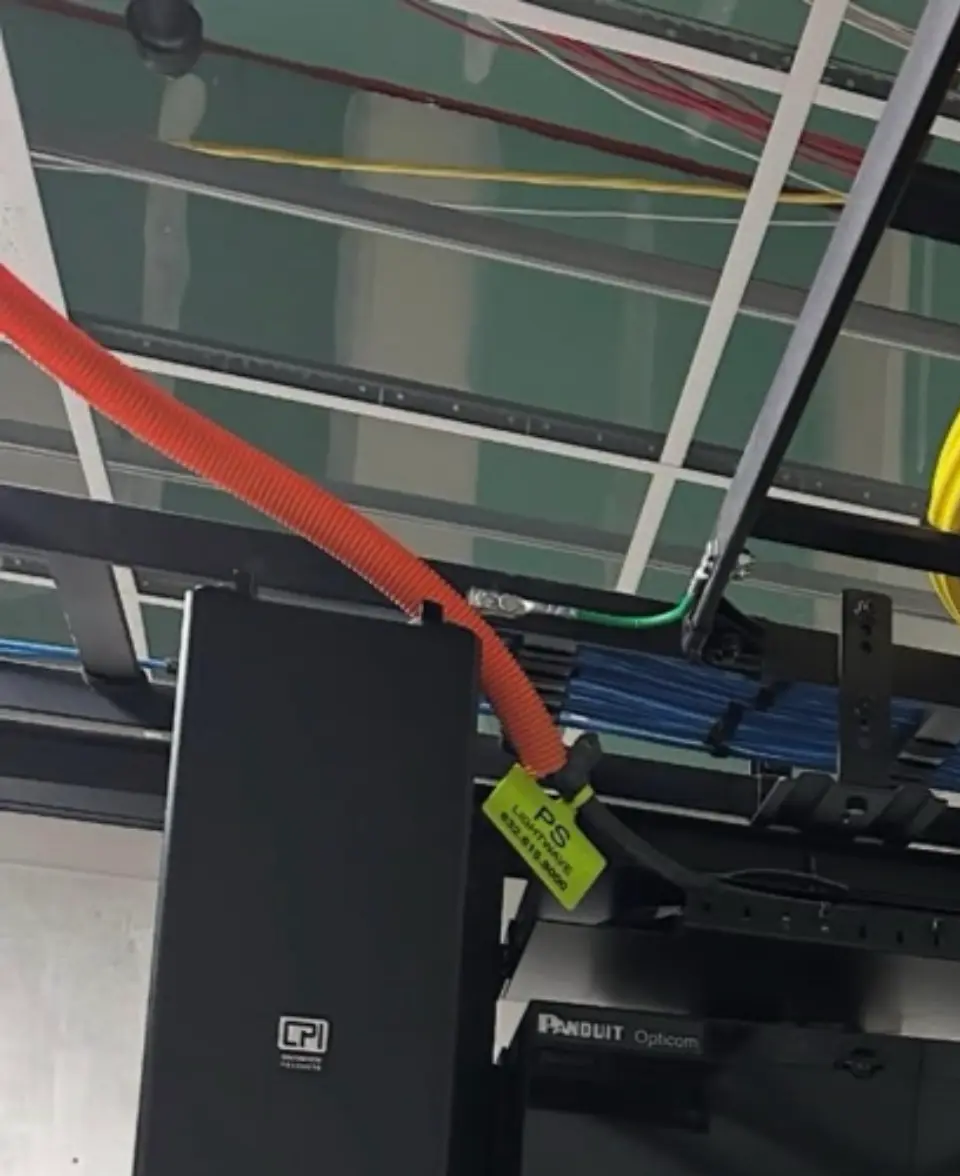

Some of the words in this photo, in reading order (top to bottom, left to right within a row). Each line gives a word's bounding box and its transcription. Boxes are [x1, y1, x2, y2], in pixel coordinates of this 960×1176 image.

[512, 804, 573, 876] LIGHTWAVE
[534, 805, 570, 848] PS
[538, 1013, 624, 1041] PANDUIT
[634, 1029, 699, 1048] Opticom
